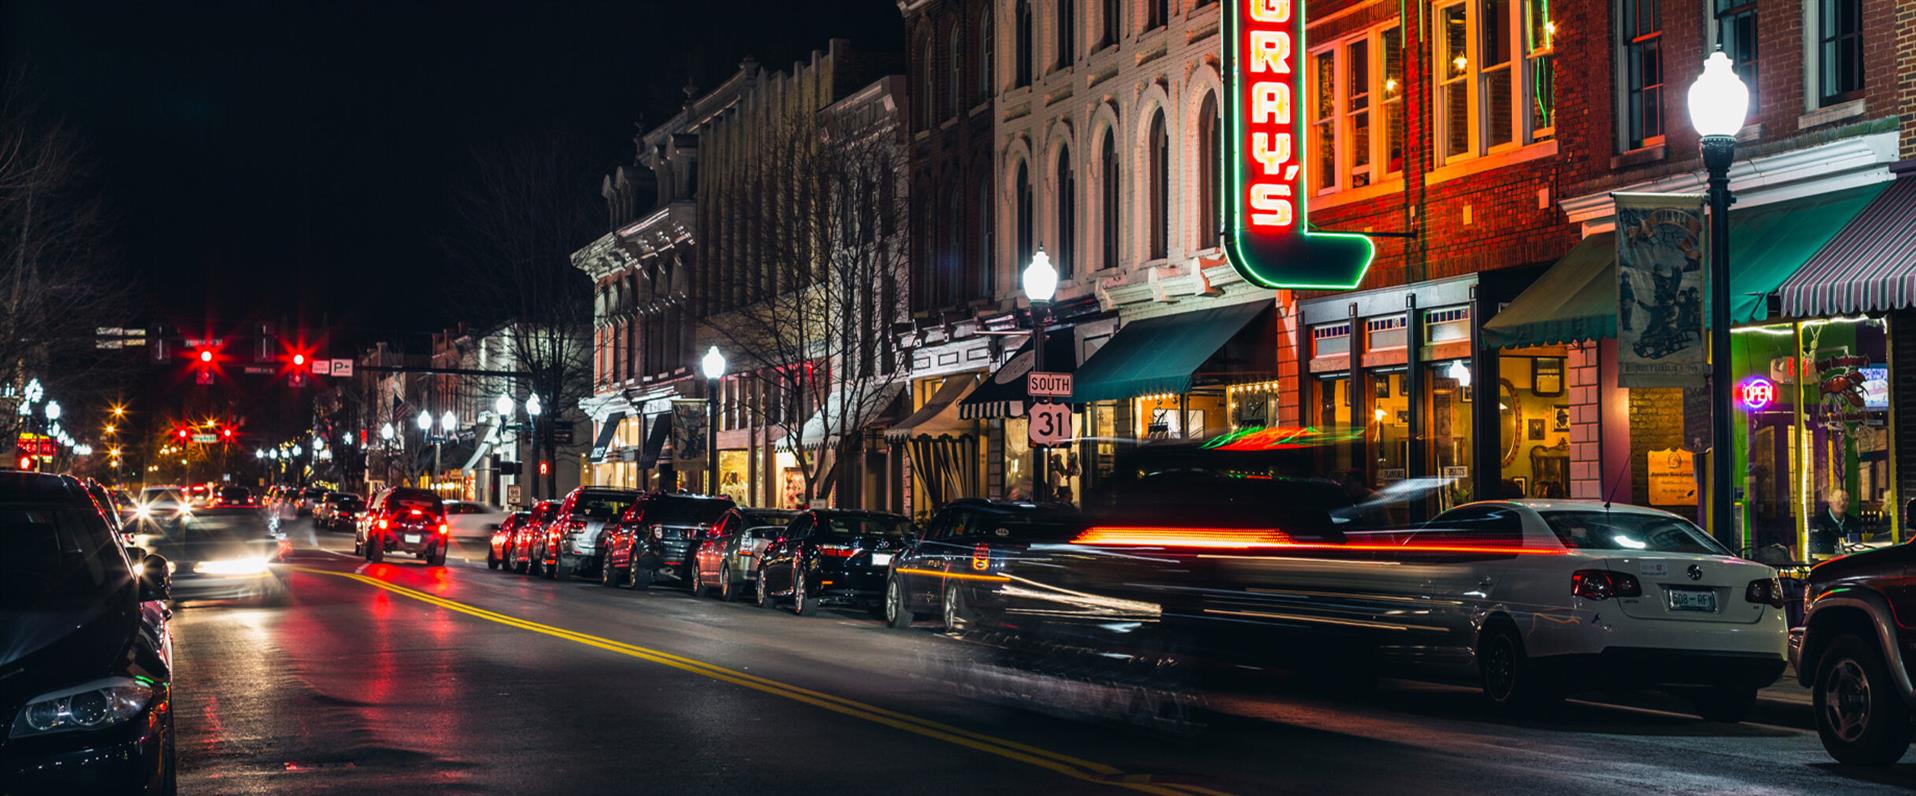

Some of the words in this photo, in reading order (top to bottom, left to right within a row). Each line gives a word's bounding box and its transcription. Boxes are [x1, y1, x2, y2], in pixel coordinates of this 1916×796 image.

[1250, 0, 1299, 226] GRAY'S
[1032, 377, 1069, 391] SOUTH
[1744, 385, 1772, 400] OPEN
[1038, 412, 1062, 437] 31
